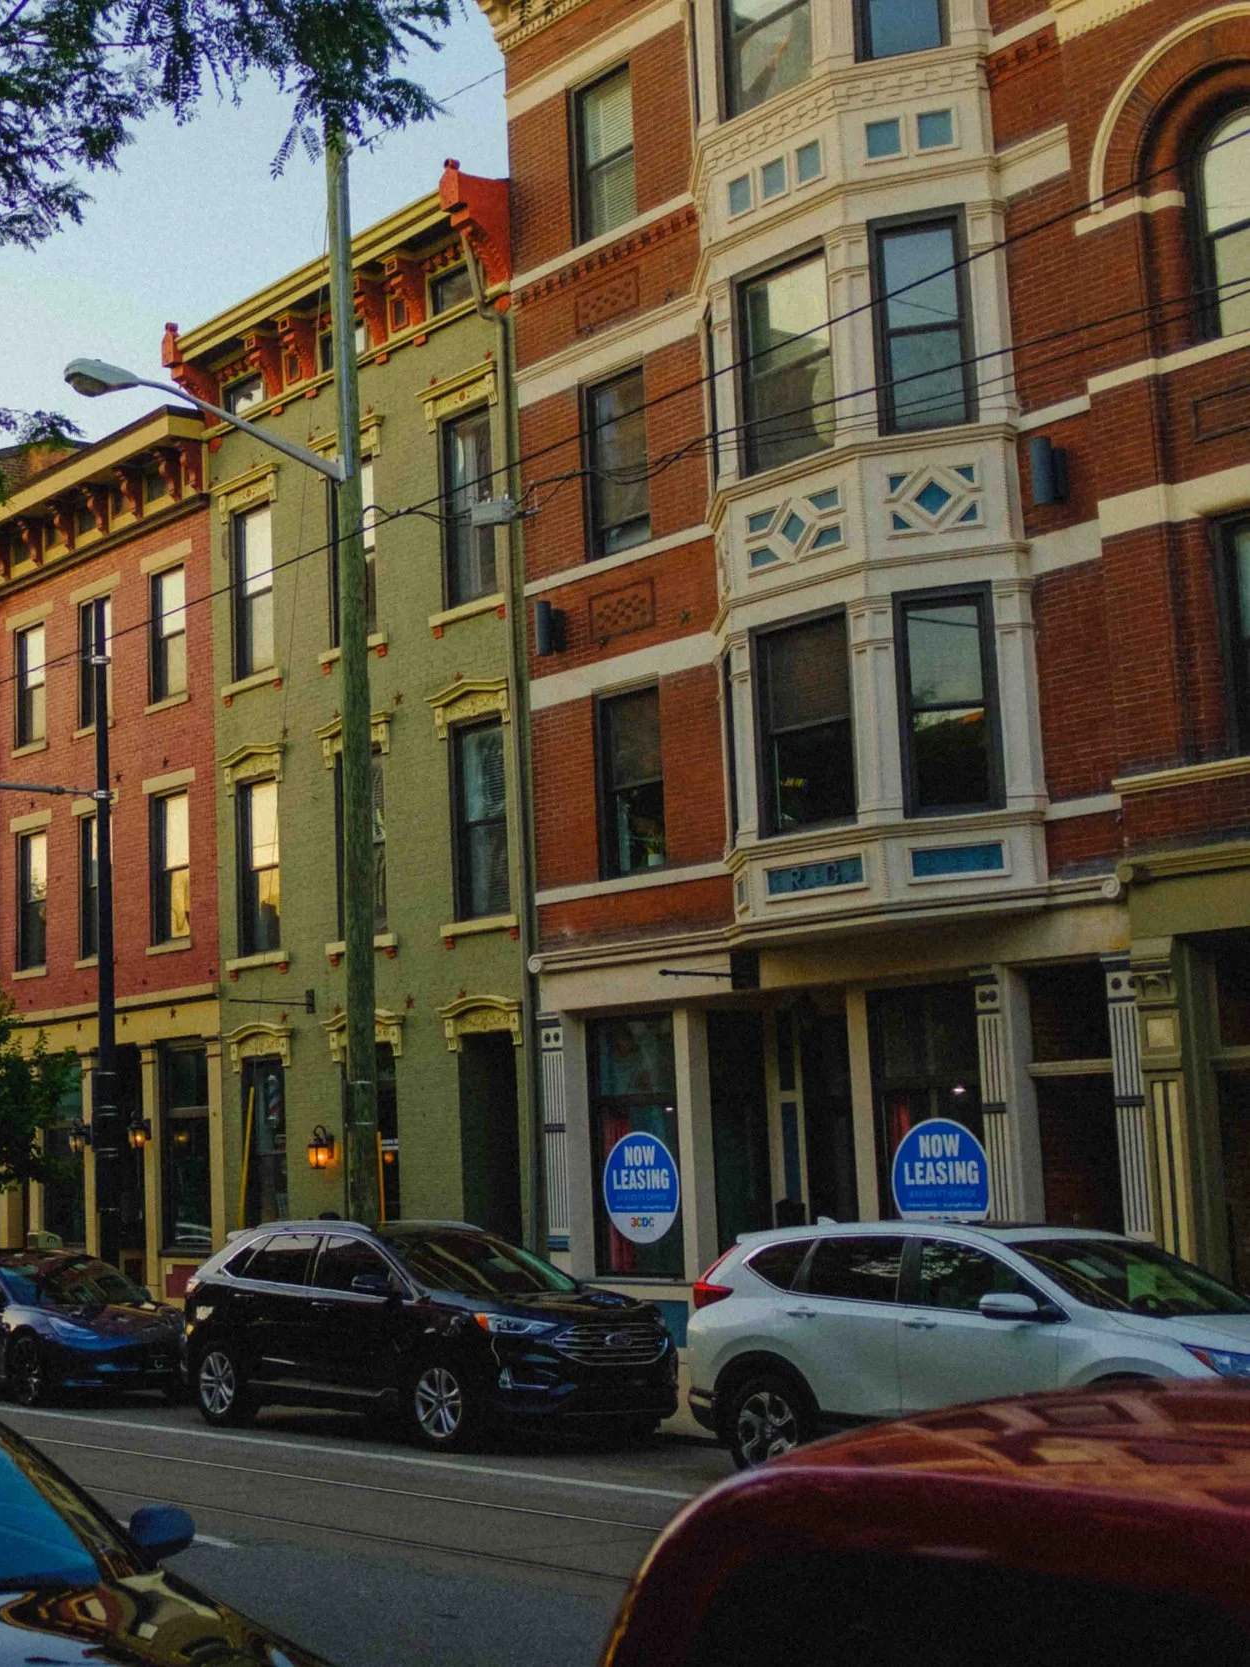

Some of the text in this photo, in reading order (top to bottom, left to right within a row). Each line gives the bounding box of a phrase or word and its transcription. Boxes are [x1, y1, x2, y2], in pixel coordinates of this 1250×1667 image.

[624, 1145, 656, 1167] NOW
[918, 1133, 960, 1158] NOW
[612, 1168, 670, 1190] LEASING
[903, 1160, 980, 1186] LEASING
[630, 1216, 655, 1229] 3CDC
